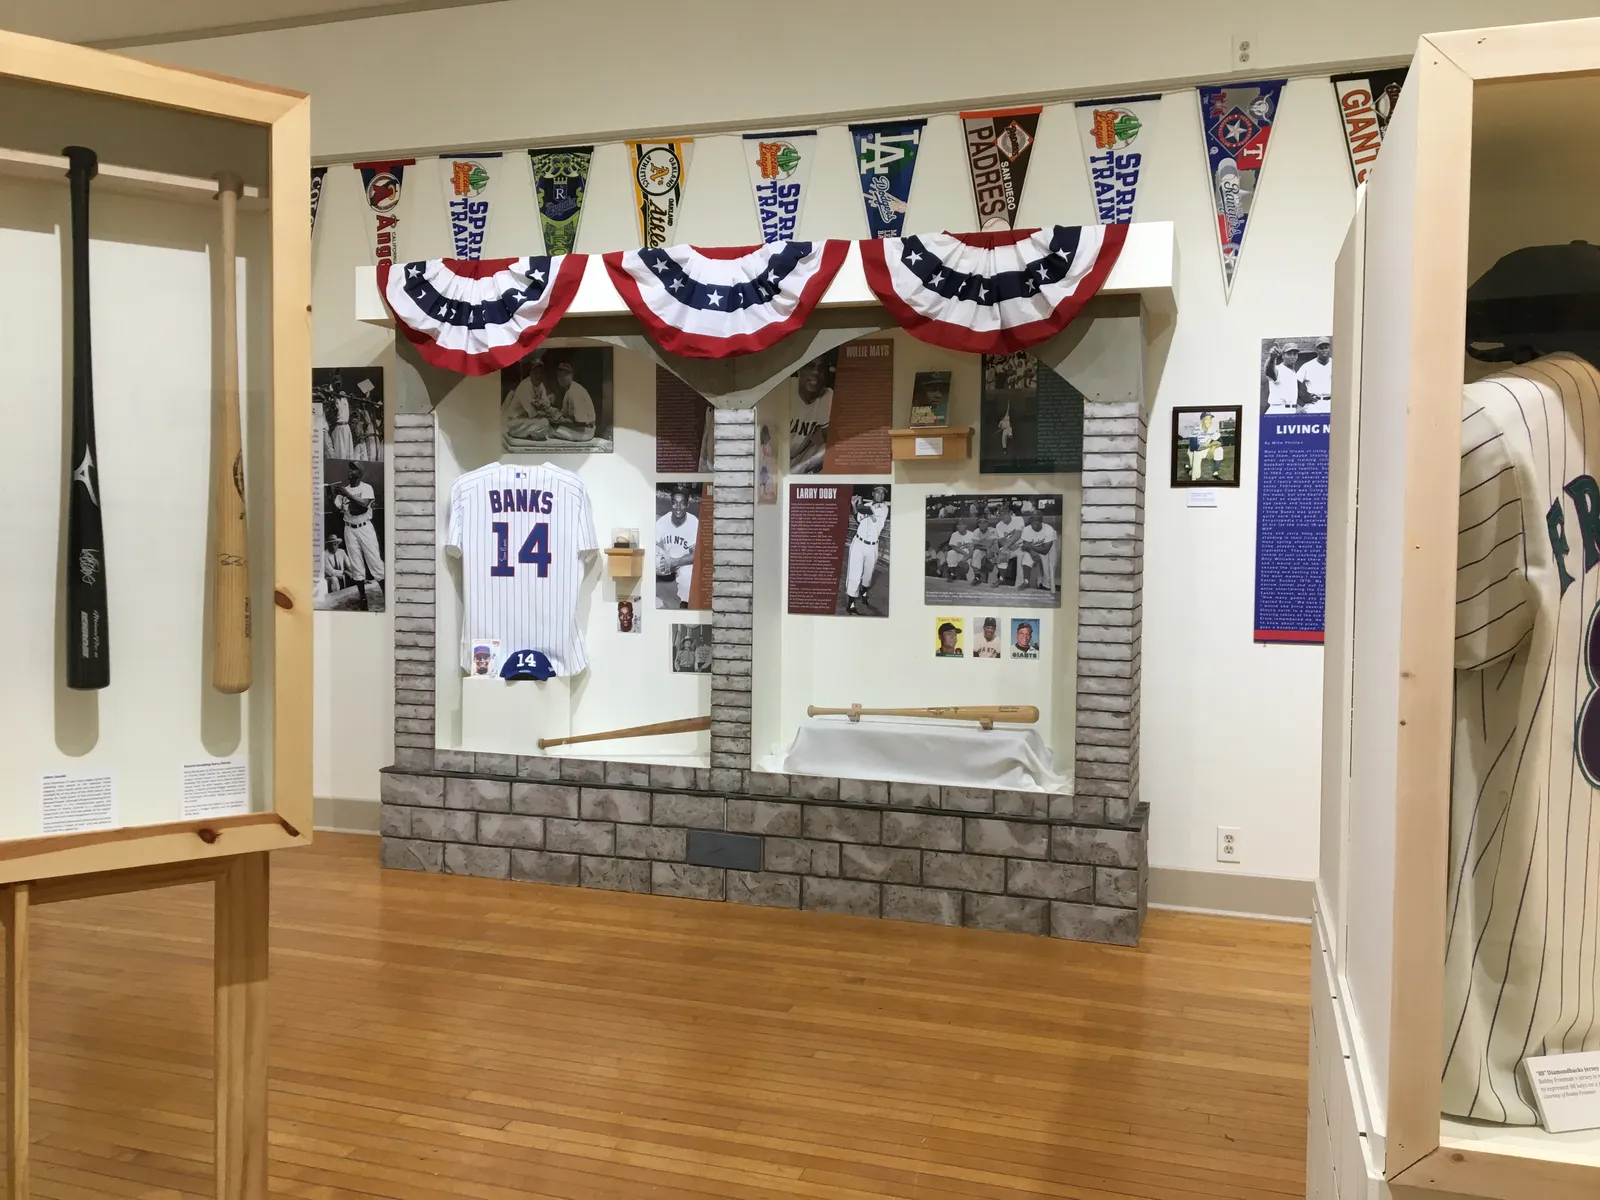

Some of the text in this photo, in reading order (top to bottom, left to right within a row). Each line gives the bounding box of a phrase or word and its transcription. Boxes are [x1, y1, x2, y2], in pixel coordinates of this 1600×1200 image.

[1090, 109, 1106, 149] League
[1106, 110, 1119, 149] Cactus
[640, 154, 652, 188] ATHLETICS
[665, 156, 678, 188] OAKLAND
[756, 142, 770, 179] League
[770, 142, 782, 179] Cactus
[968, 125, 1006, 216] PADRES
[555, 188, 566, 200] R
[868, 176, 897, 224] Dodgers
[1001, 161, 1016, 210] SAN DIEGO
[667, 198, 675, 227] OAKLAND
[1220, 180, 1245, 240] Rangers
[846, 344, 889, 358] WILLIE MAYS
[1276, 424, 1320, 435] LIVING
[489, 489, 553, 514] BANKS
[796, 488, 838, 500] LARRY DOBY
[491, 522, 552, 577] 14
[516, 653, 536, 668] 14
[1547, 1067, 1584, 1076] Diamondbacks
